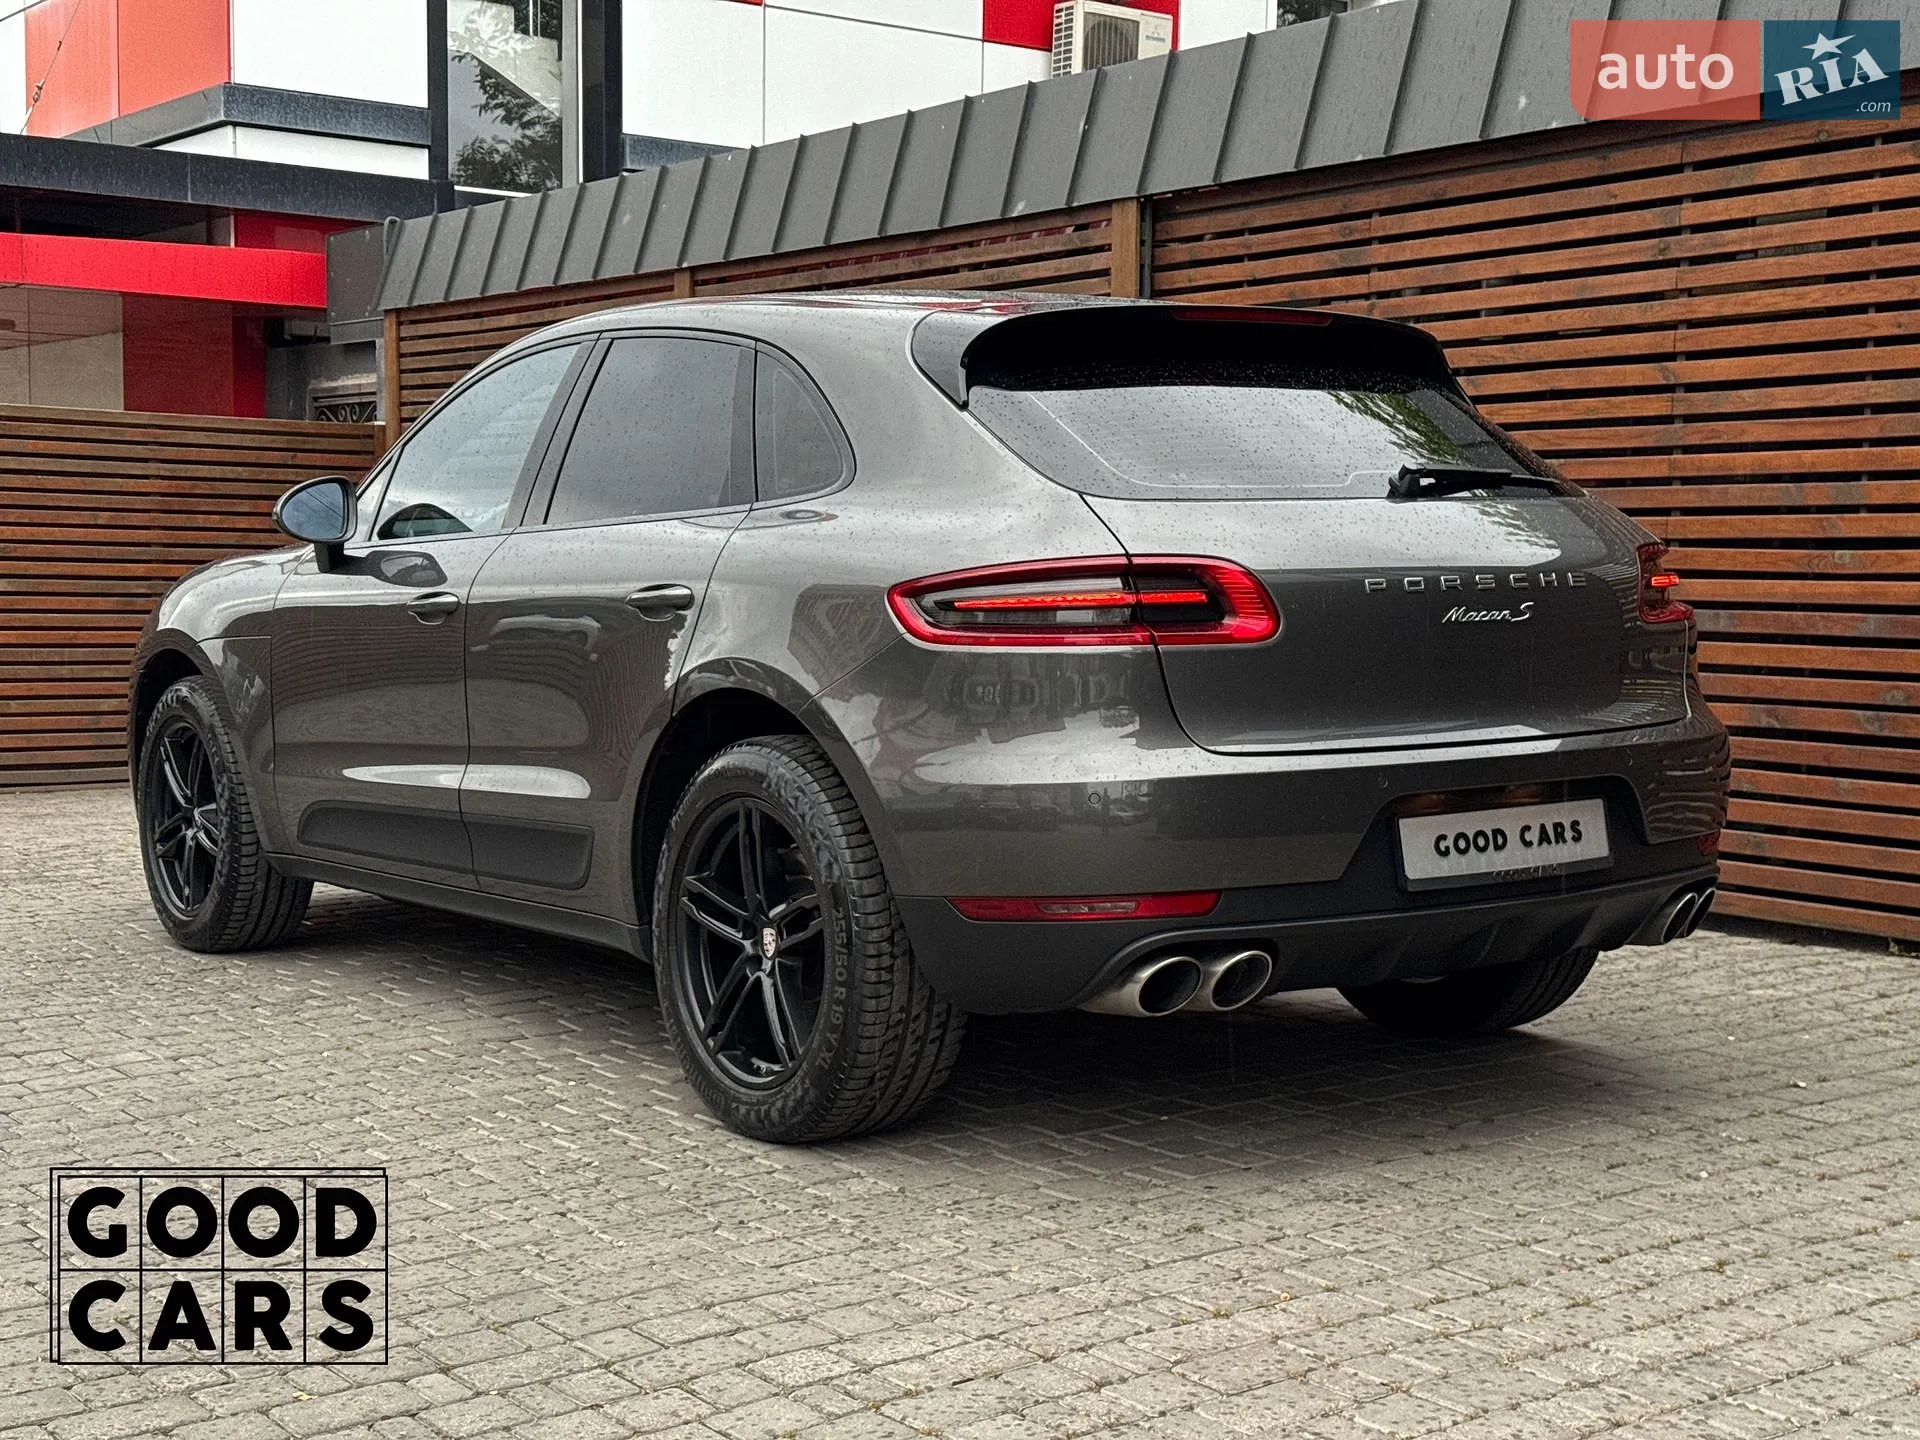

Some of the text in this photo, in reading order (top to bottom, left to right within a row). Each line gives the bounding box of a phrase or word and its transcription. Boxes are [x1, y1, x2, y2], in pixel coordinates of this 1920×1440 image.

[1364, 572, 1588, 594] PORSCHE
[1441, 602, 1535, 624] Macan S
[1433, 819, 1583, 857] GOOD CARS
